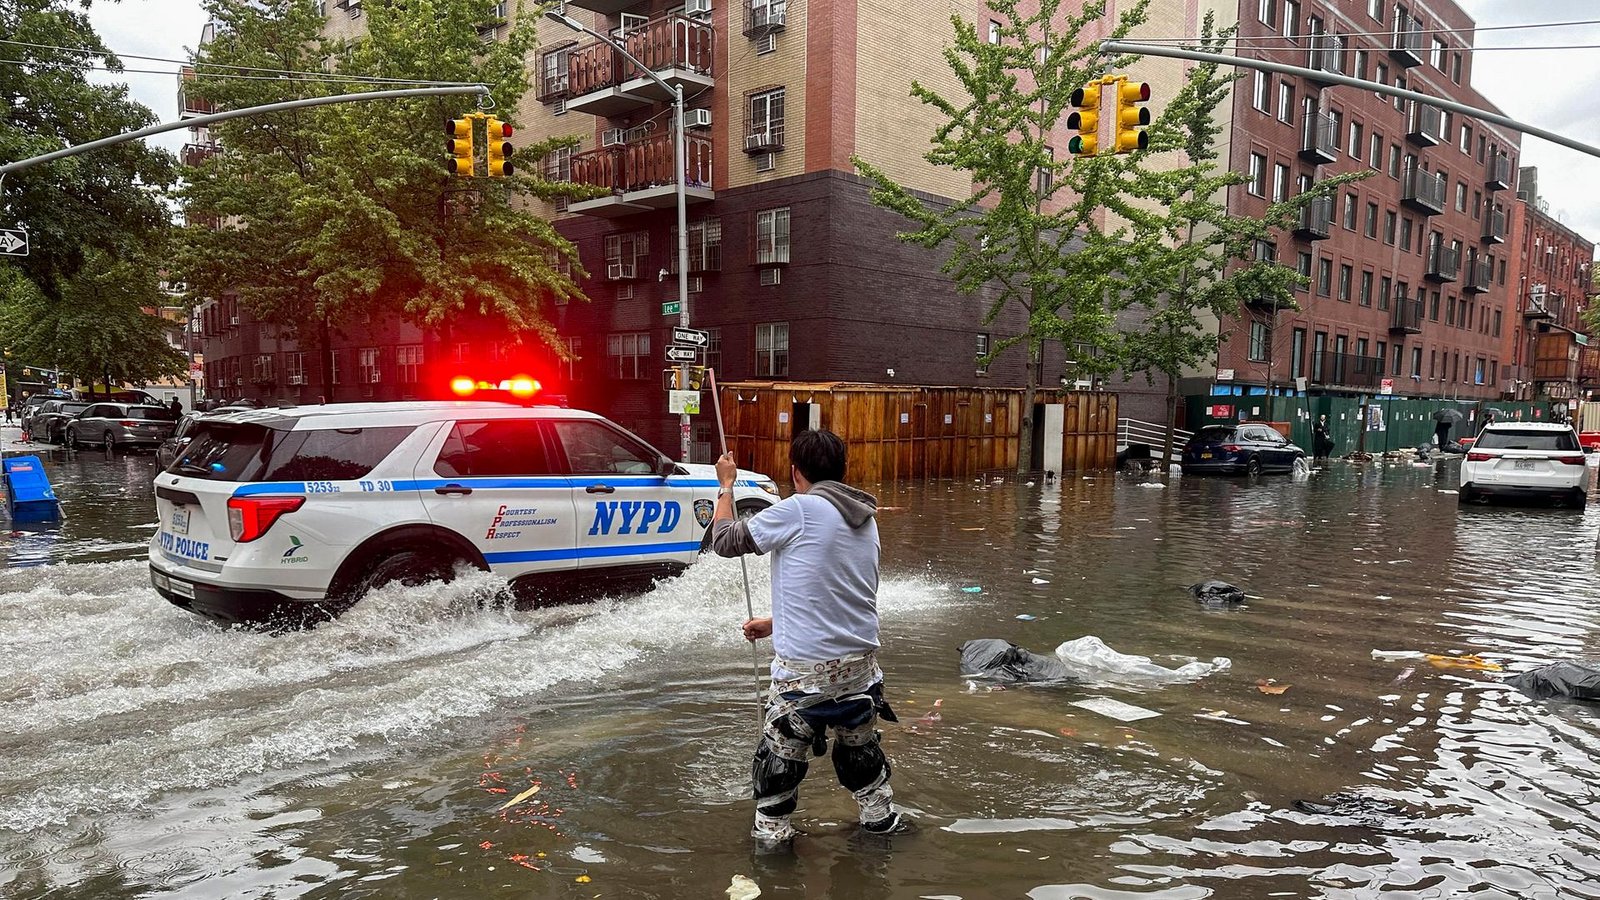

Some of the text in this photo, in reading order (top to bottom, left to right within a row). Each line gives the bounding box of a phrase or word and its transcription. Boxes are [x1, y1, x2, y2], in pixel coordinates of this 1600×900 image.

[0, 236, 16, 247] AY
[664, 305, 674, 313] Lee
[677, 332, 689, 340] ONE
[360, 480, 374, 492] TD
[377, 480, 391, 492] 30
[588, 501, 681, 535] NYPD
[175, 537, 209, 560] POLICE
[281, 556, 309, 565] HYBRID
